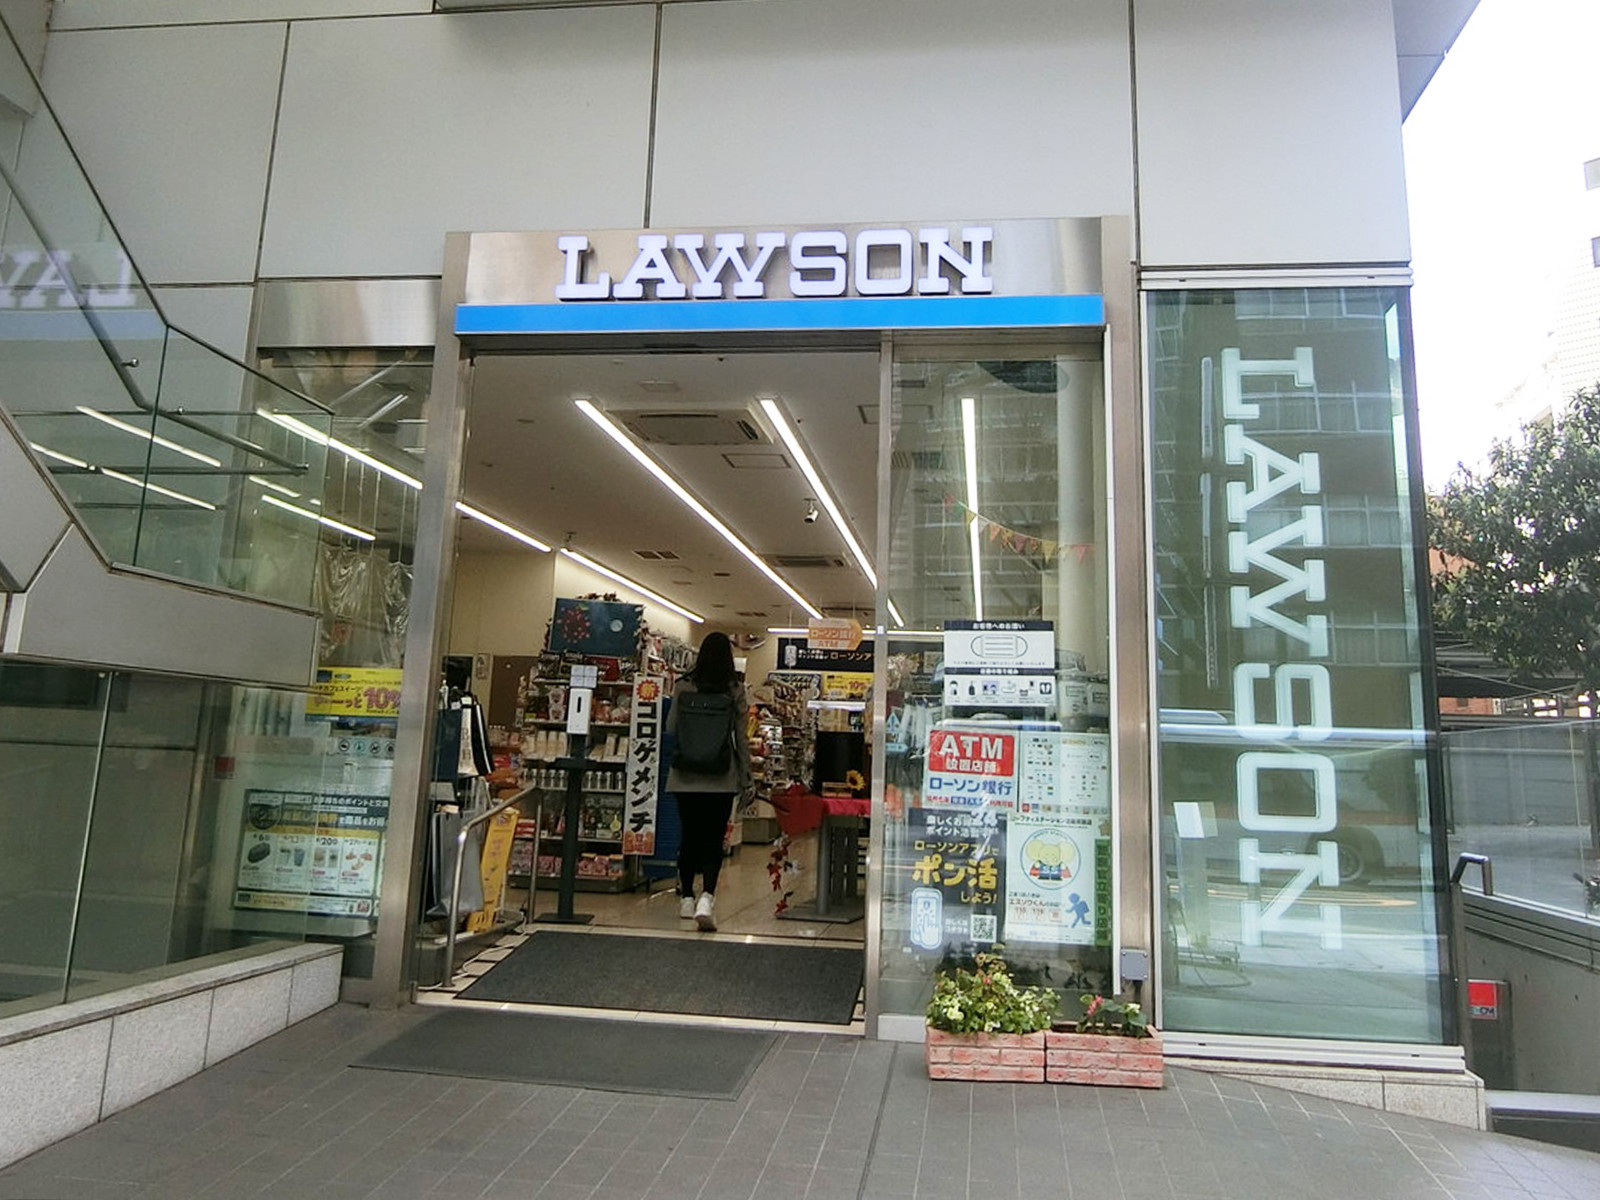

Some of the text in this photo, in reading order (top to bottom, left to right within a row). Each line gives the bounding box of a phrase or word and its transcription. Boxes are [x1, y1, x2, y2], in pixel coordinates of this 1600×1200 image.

[555, 227, 993, 299] LAWSON
[1221, 347, 1342, 950] LAWSON
[939, 734, 1003, 760] ATM
[946, 758, 997, 773] 設置店舗
[929, 777, 1013, 796] ローソン銀行
[912, 853, 998, 889] ポン活
